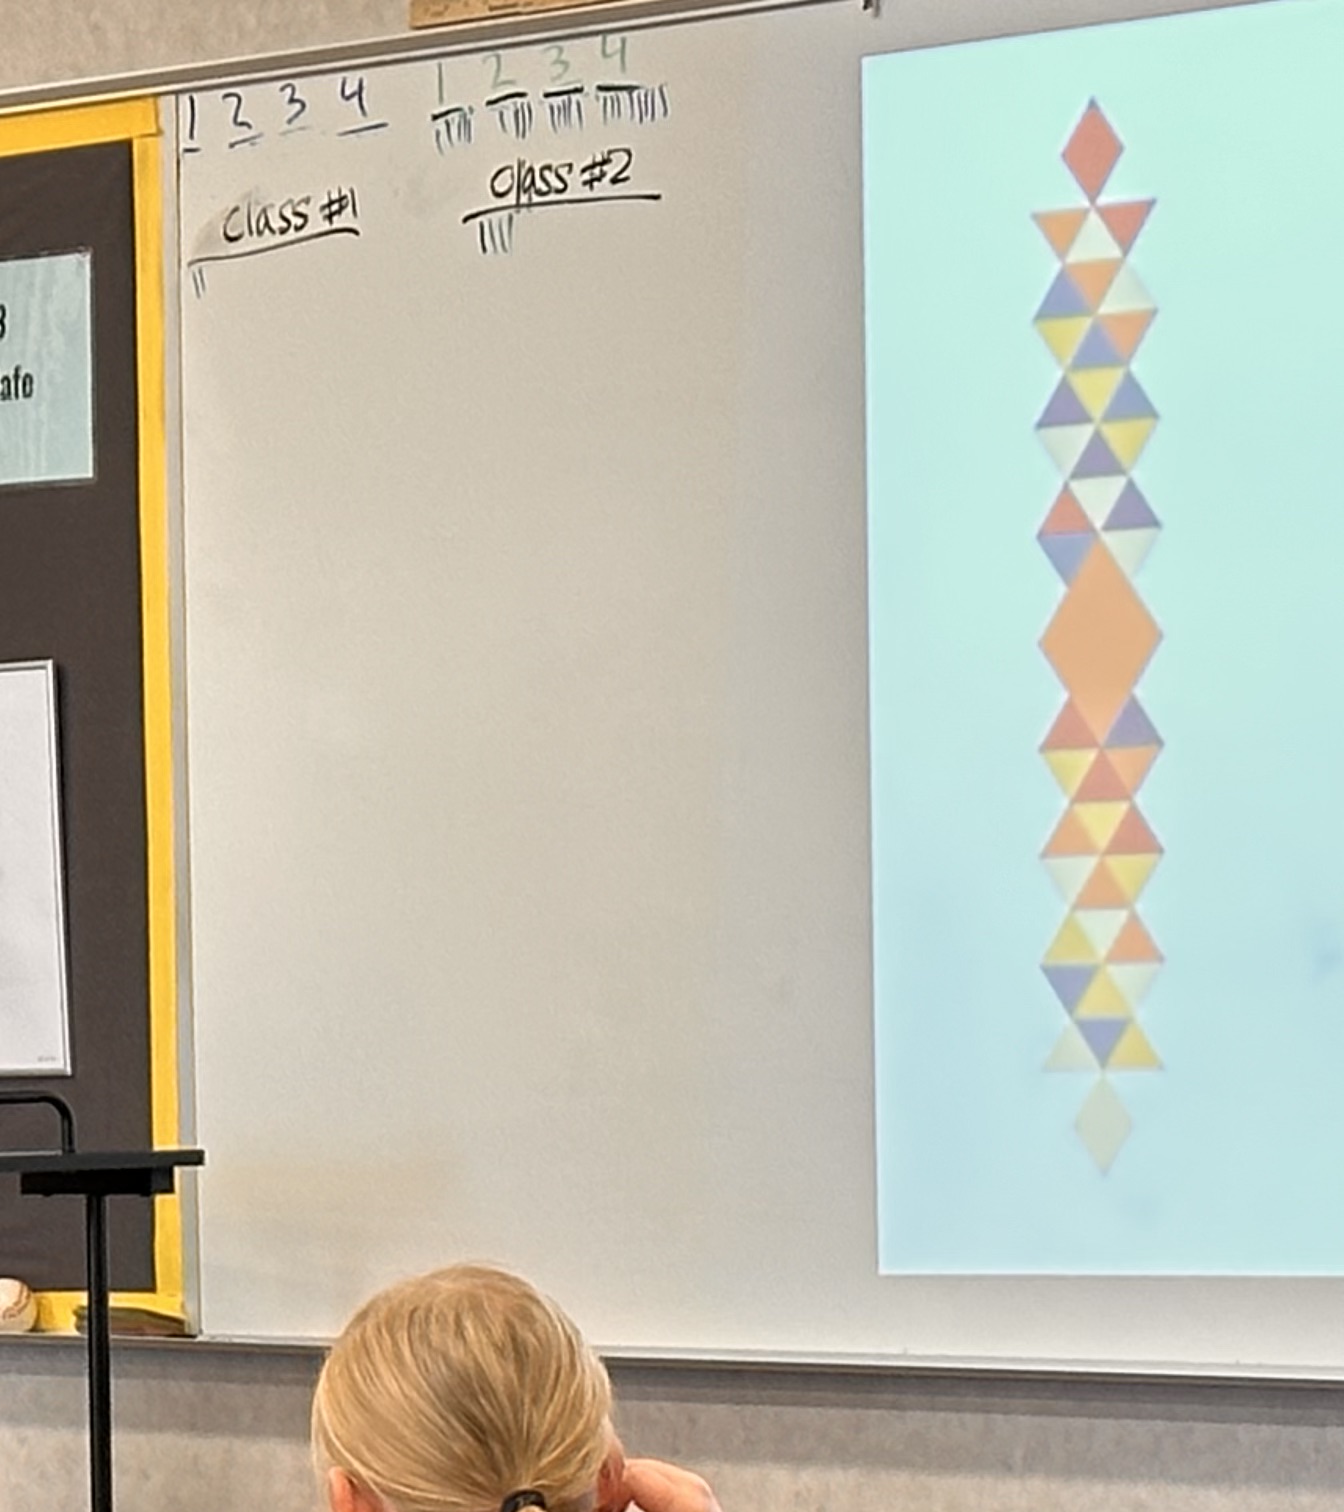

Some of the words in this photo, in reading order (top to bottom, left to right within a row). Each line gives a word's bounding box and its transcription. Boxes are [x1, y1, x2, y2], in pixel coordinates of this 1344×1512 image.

[222, 93, 257, 130] 2
[279, 84, 306, 125] 3
[339, 77, 368, 116] 4
[580, 148, 632, 191] #2
[319, 185, 358, 226] #1
